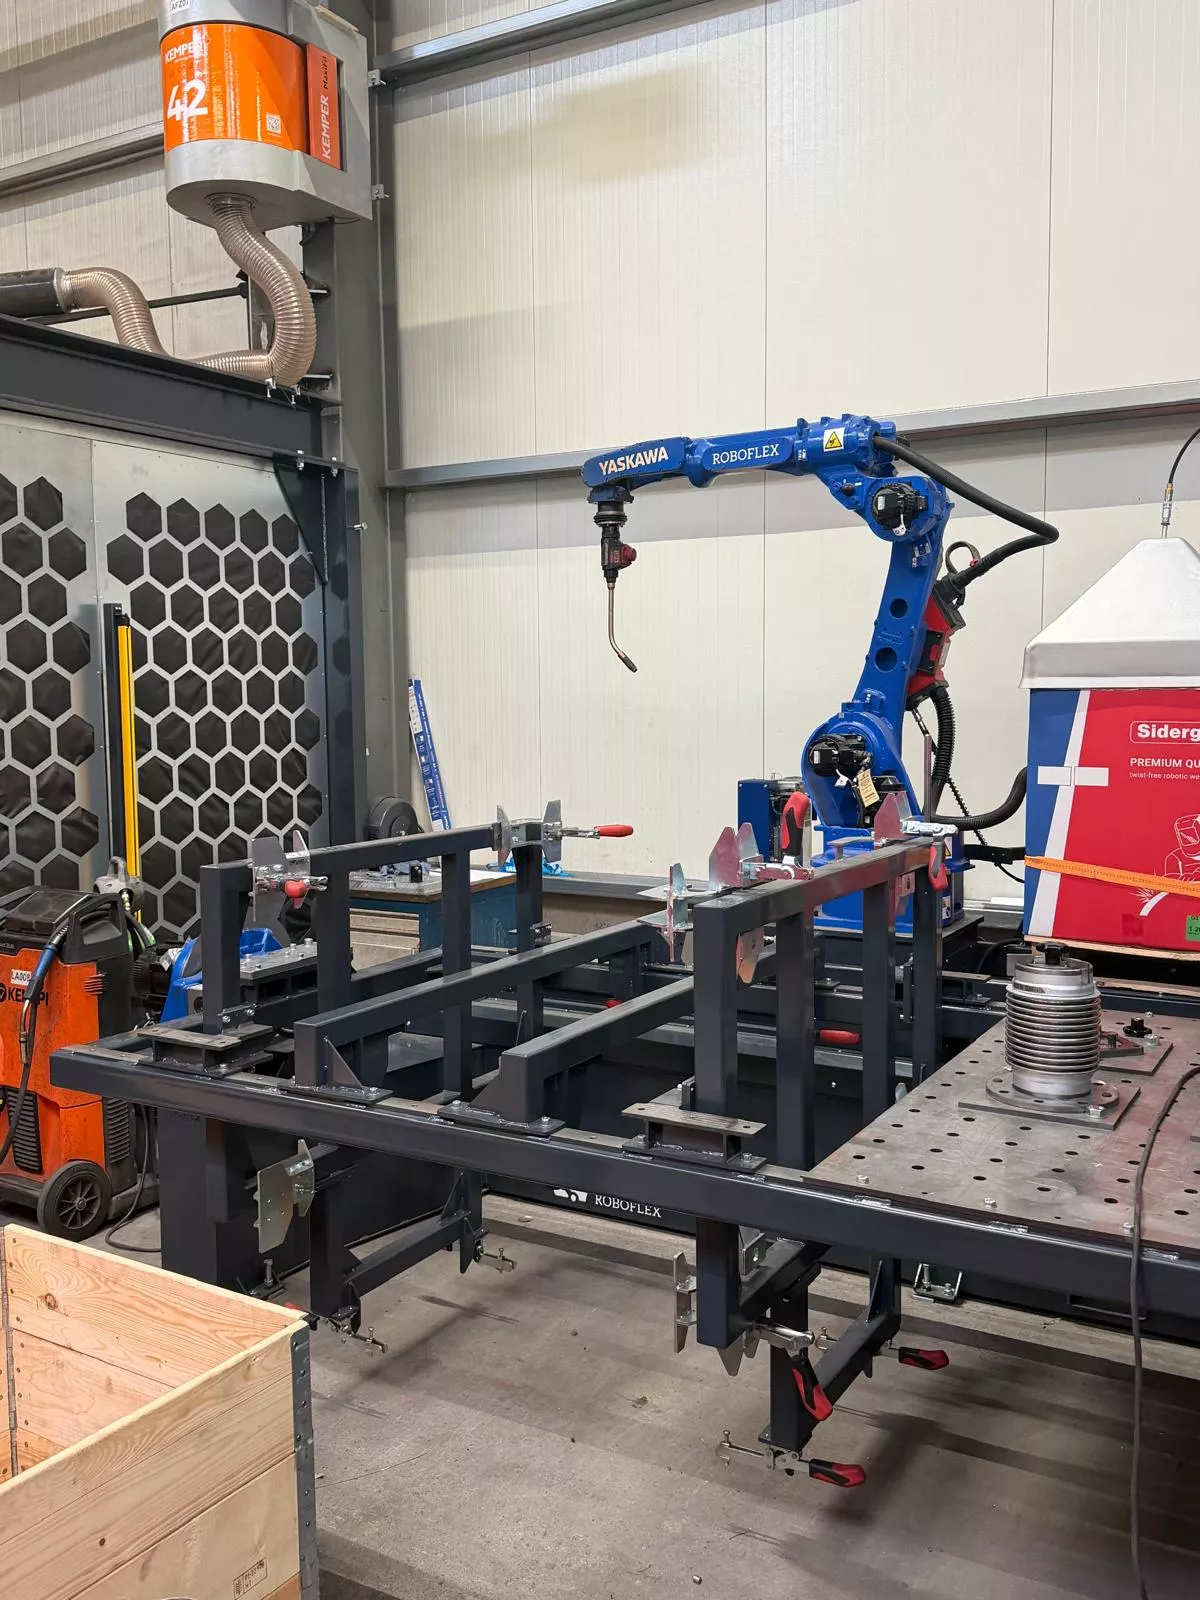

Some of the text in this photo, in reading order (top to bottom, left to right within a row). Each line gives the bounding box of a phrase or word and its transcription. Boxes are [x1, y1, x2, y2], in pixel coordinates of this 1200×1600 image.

[167, 78, 208, 121] 42
[320, 94, 331, 160] KEMPER
[598, 446, 669, 476] YASKAWA
[712, 443, 780, 465] ROBOFLEX
[1137, 723, 1200, 742] Siderg
[1130, 757, 1182, 768] PREMIUM
[1129, 771, 1162, 779] twist-free
[594, 1194, 662, 1218] ROBOFLEX
